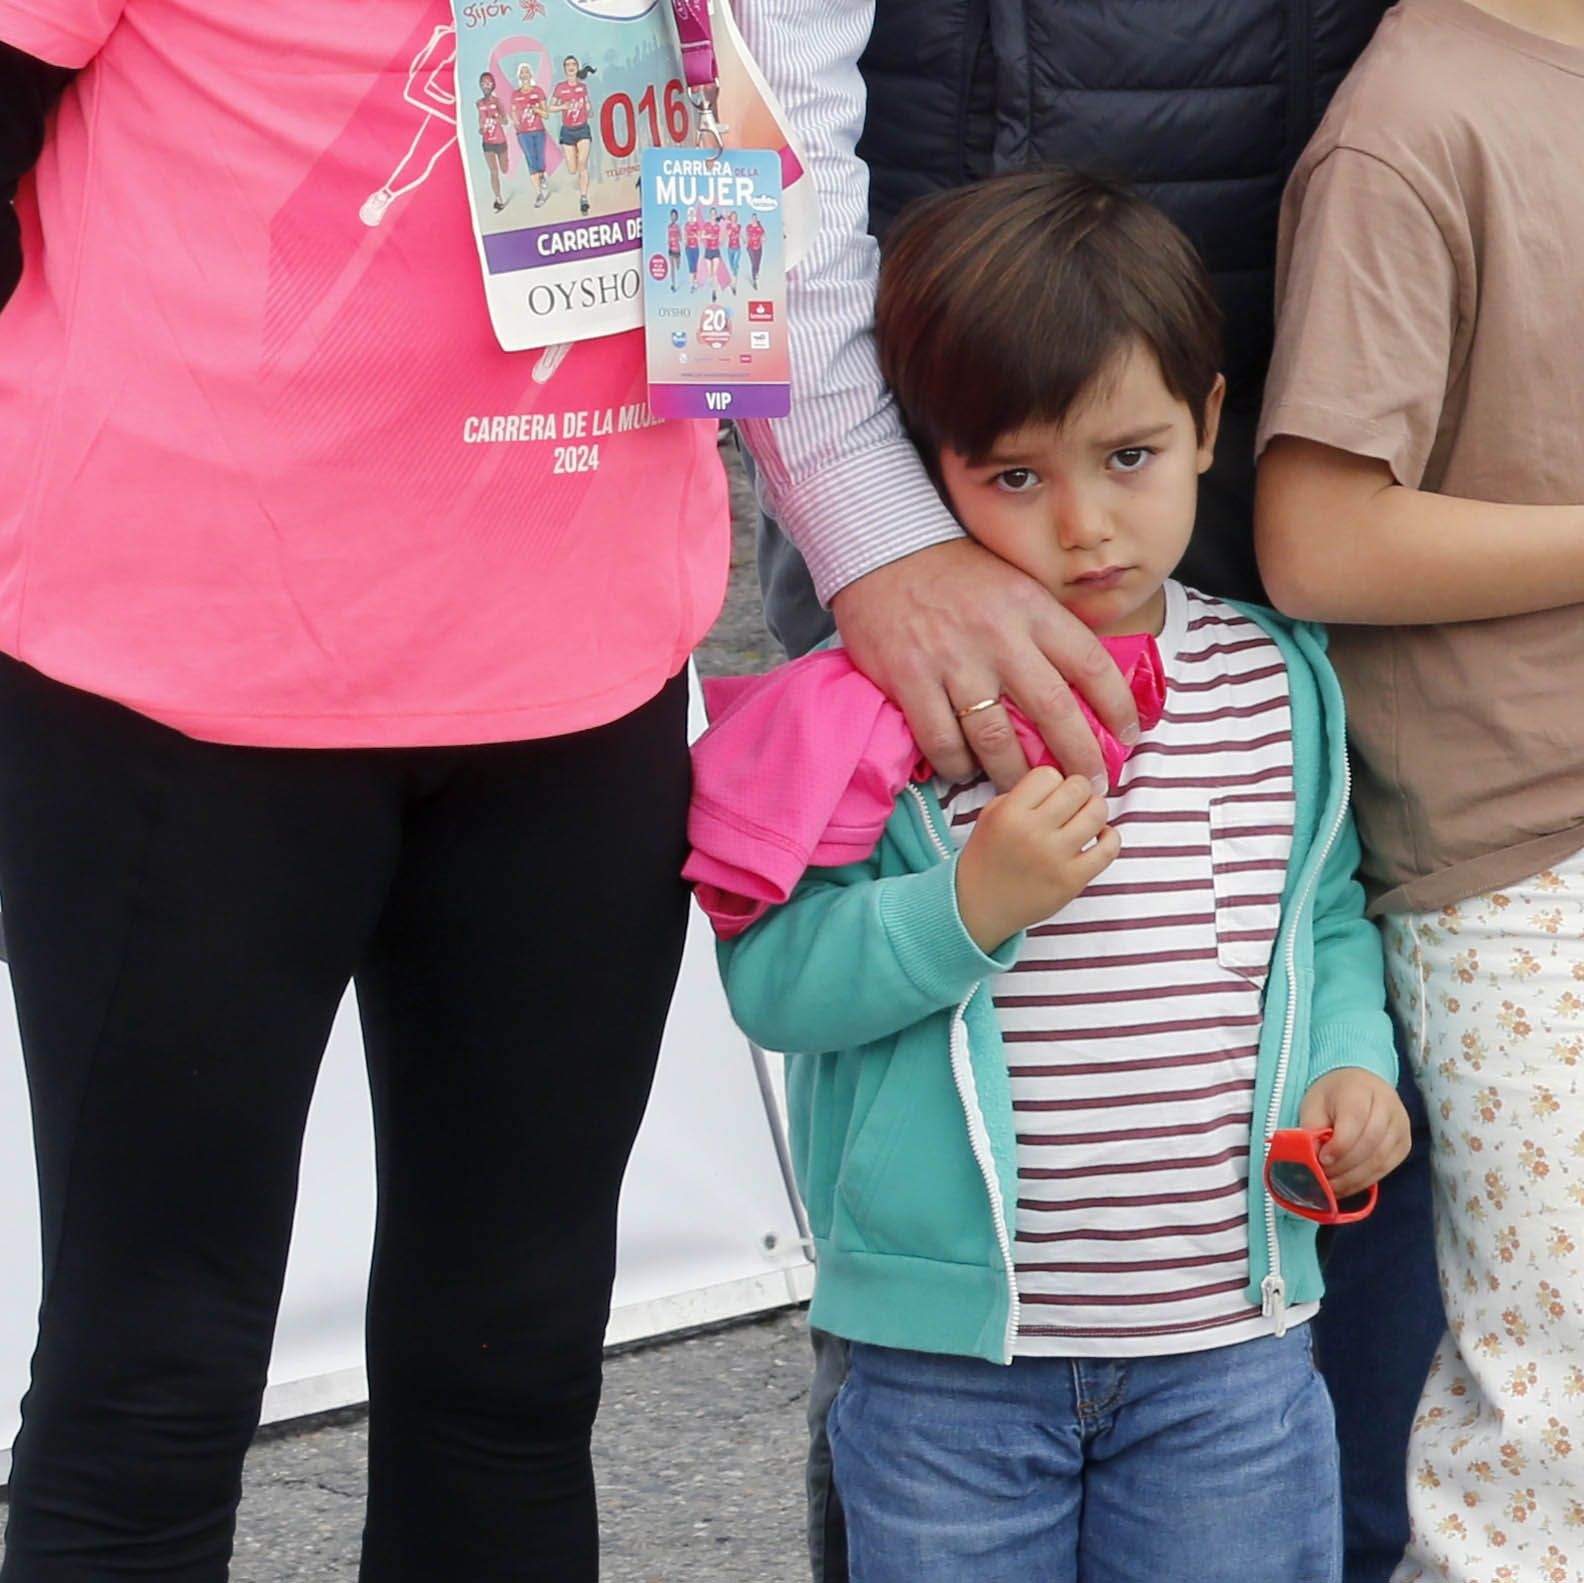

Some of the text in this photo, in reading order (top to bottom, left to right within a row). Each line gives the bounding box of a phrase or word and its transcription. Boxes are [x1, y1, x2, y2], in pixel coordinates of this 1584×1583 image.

[599, 78, 689, 158] 016
[663, 160, 732, 177] CARRERA
[656, 176, 754, 206] MUJER
[537, 222, 623, 257] CARRERA
[528, 268, 641, 316] OYSHO
[702, 309, 727, 331] 20
[705, 392, 732, 411] VIP
[463, 413, 557, 443] CARRERA
[562, 411, 588, 440] DE
[592, 408, 613, 437] LA
[553, 444, 599, 475] 2024
